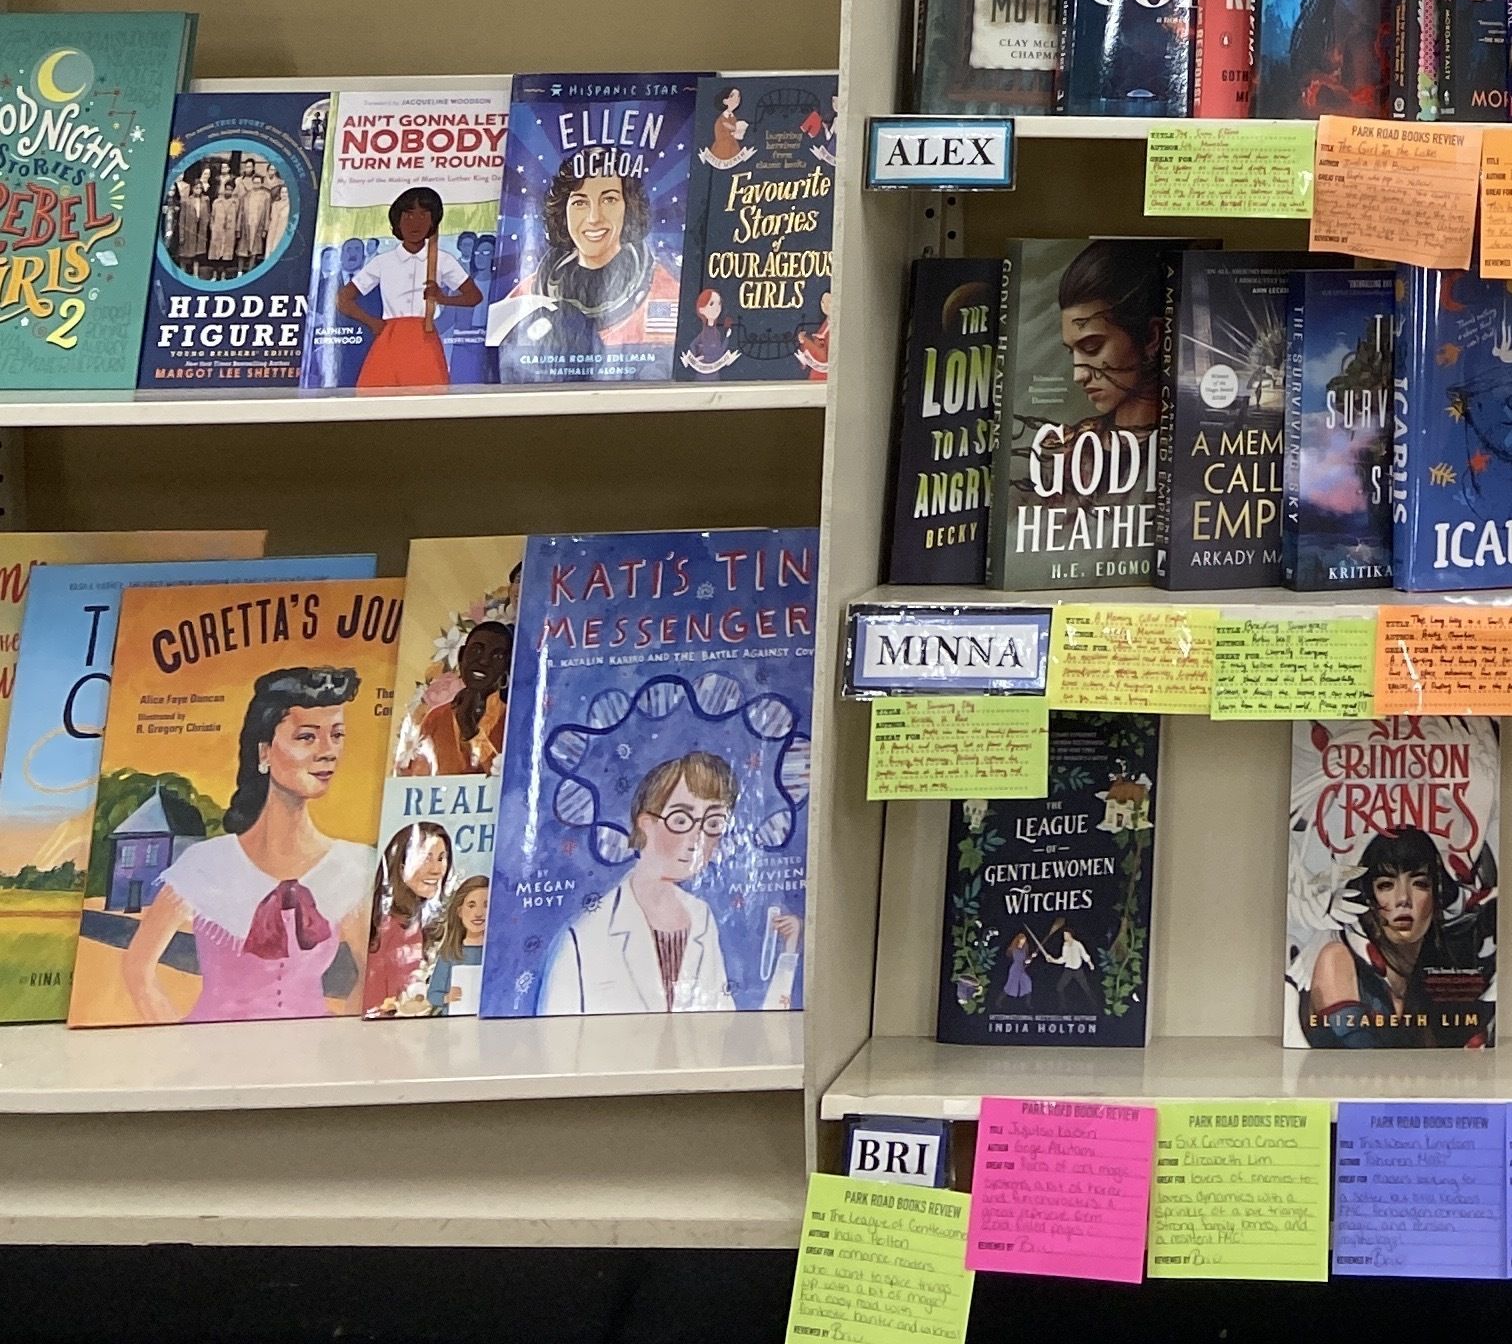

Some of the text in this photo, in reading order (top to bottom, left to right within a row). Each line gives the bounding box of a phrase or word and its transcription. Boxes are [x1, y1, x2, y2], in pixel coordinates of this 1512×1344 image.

[343, 113, 509, 127] AIN'T GONNA LET
[559, 110, 663, 149] ELLEN
[341, 127, 509, 154] NOBODY
[885, 137, 994, 166] ALEX
[339, 155, 505, 170] TURN ME 'ROUND
[574, 151, 643, 179] OCHOA
[153, 595, 319, 673] CORETTA'S
[876, 635, 1024, 667] MINNA
[1321, 743, 1470, 779] CRIMSON
[1315, 781, 1479, 854] CRANES
[1309, 1013, 1478, 1027] ELIZABETH LIM
[855, 1138, 931, 1175] BRI
